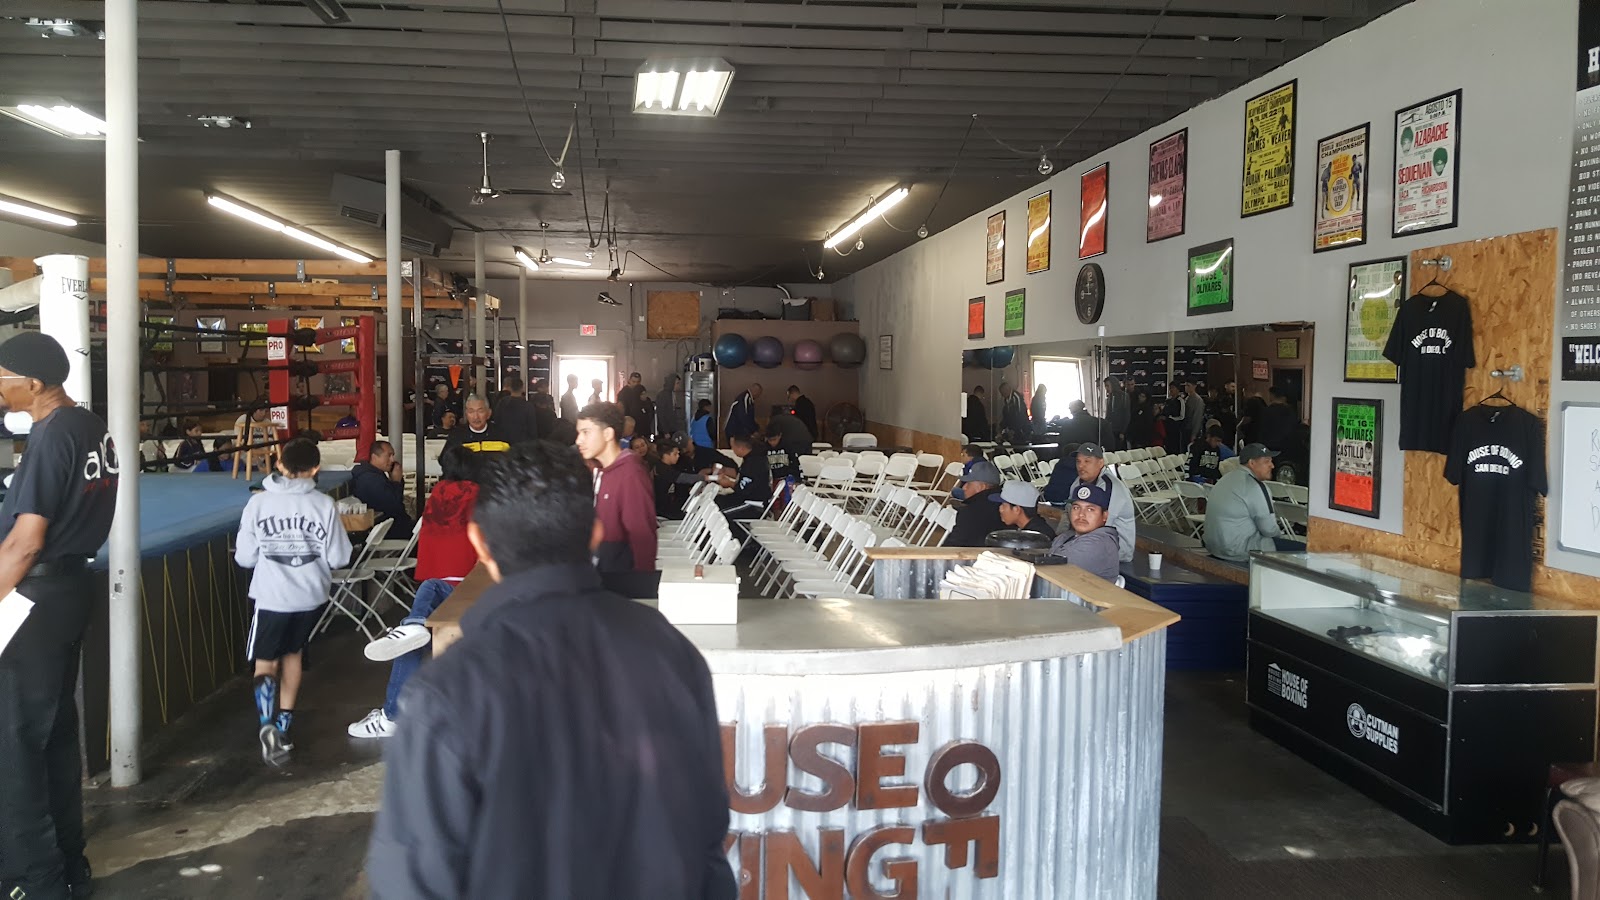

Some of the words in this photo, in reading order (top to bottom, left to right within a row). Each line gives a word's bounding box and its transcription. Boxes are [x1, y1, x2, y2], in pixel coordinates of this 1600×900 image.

[1247, 138, 1265, 154] HOLMES
[1271, 128, 1291, 145] WEAVER
[1414, 122, 1449, 148] AZABACHE
[1321, 140, 1366, 158] CHAMPIONSHIP
[1398, 161, 1432, 185] SEQUENAN
[1244, 196, 1265, 210] OLYMPIC
[1573, 246, 1595, 256] STOLEN
[1572, 259, 1593, 268] PROPER
[1196, 281, 1222, 295] OLIVARES
[1570, 297, 1594, 306] ALWAYS
[1429, 327, 1437, 338] OF
[1580, 322, 1597, 330] SHOES
[268, 341, 284, 351] PRO
[271, 411, 286, 420] PRO
[1357, 420, 1368, 428] 16
[1345, 427, 1374, 442] OLIVARES
[1336, 444, 1364, 459] CASTILLO
[1490, 445, 1500, 456] OF
[1474, 463, 1489, 473] SAN
[258, 513, 327, 541] United
[1281, 669, 1300, 690] HOUSE
[1300, 677, 1309, 694] OF
[1281, 683, 1308, 708] BOXING
[1366, 713, 1400, 740] CUTMAN
[1365, 726, 1399, 755] SUPPLIES
[719, 720, 920, 815] USE
